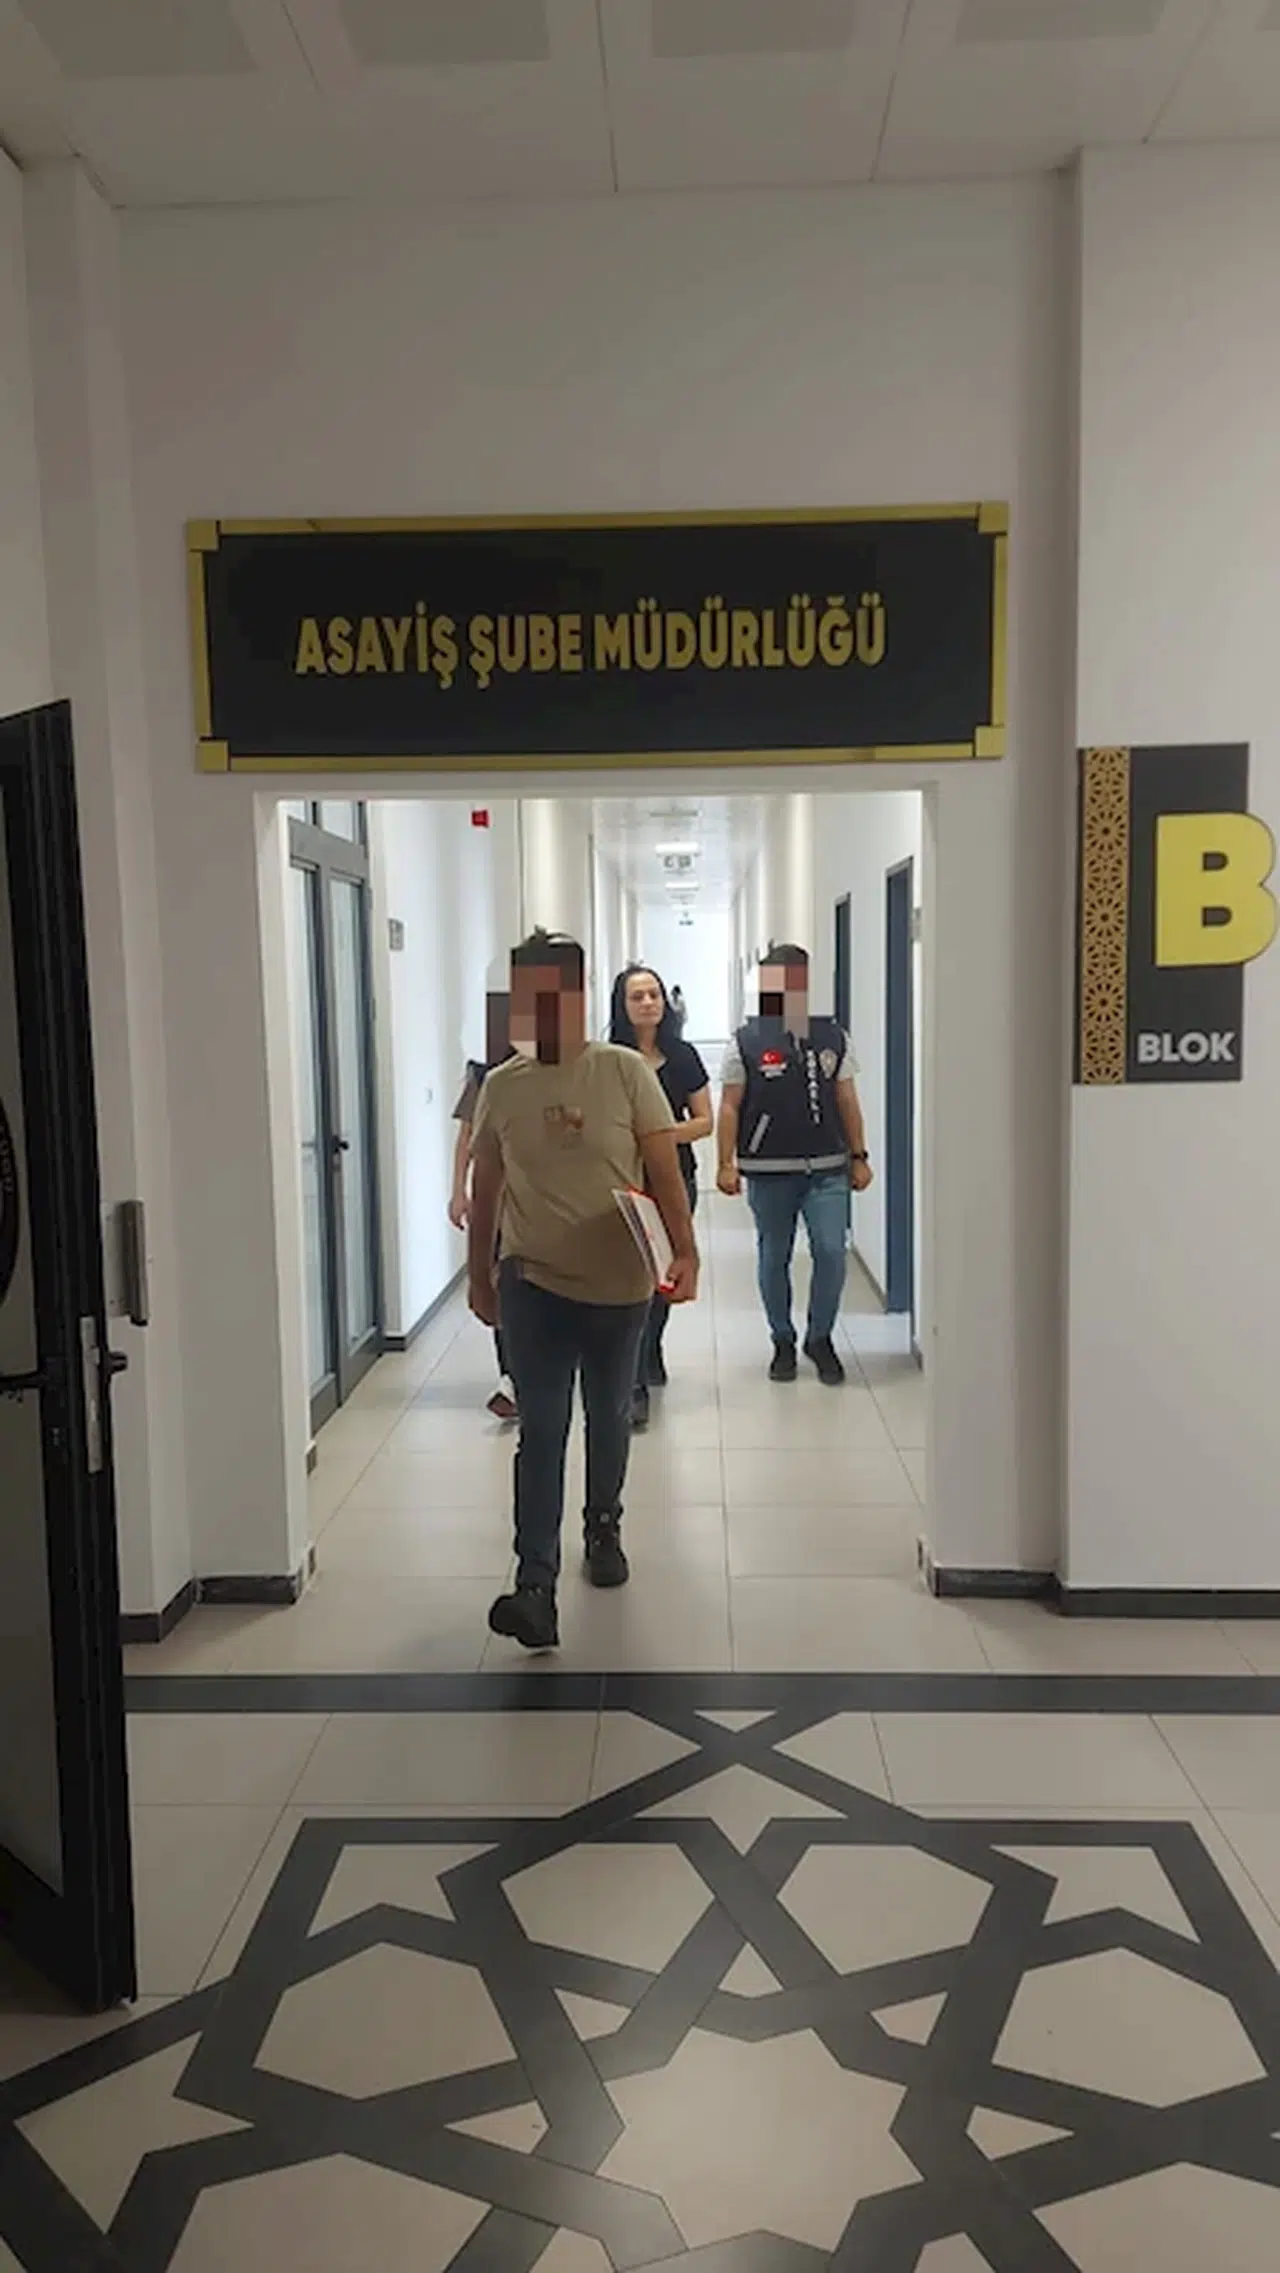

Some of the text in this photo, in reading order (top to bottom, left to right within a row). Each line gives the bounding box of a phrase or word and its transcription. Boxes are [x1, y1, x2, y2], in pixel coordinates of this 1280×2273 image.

[295, 591, 886, 690] ASAYİŞ ŞUBE MÜDÜRLÜĞÜ
[1155, 812, 1278, 968] B
[1137, 1032, 1235, 1063] BLOK
